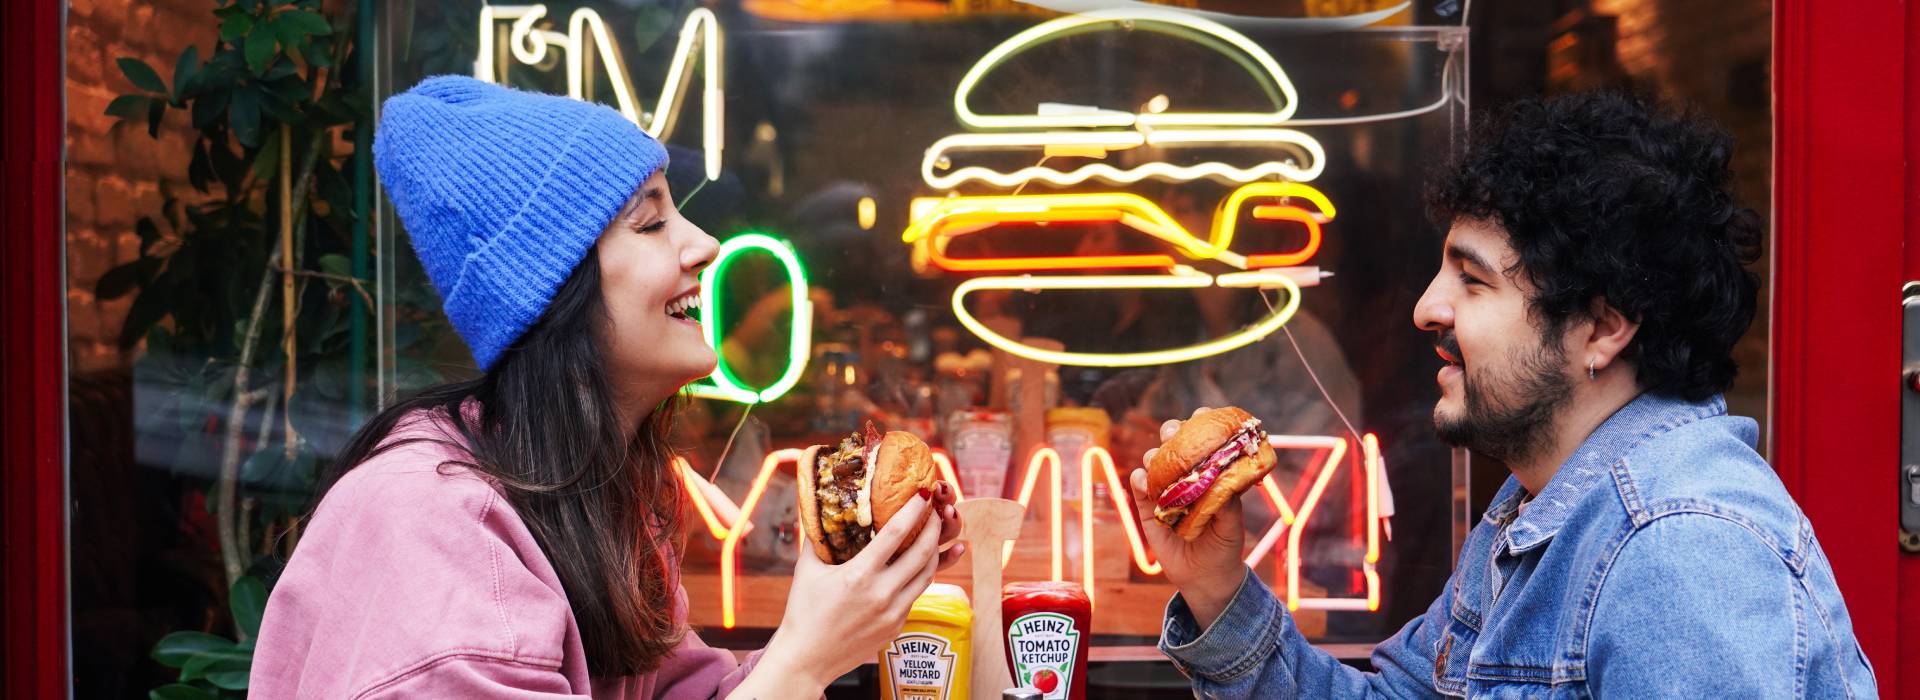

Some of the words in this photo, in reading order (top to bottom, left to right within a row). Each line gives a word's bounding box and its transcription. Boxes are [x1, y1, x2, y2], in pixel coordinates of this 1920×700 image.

[1024, 619, 1065, 634] HEINZ
[901, 641, 938, 656] HEINZ
[1018, 639, 1070, 653] TOMATO
[903, 659, 936, 669] YELLOW
[1021, 652, 1068, 664] KETCHUP
[899, 668, 941, 680] MUSTARD
